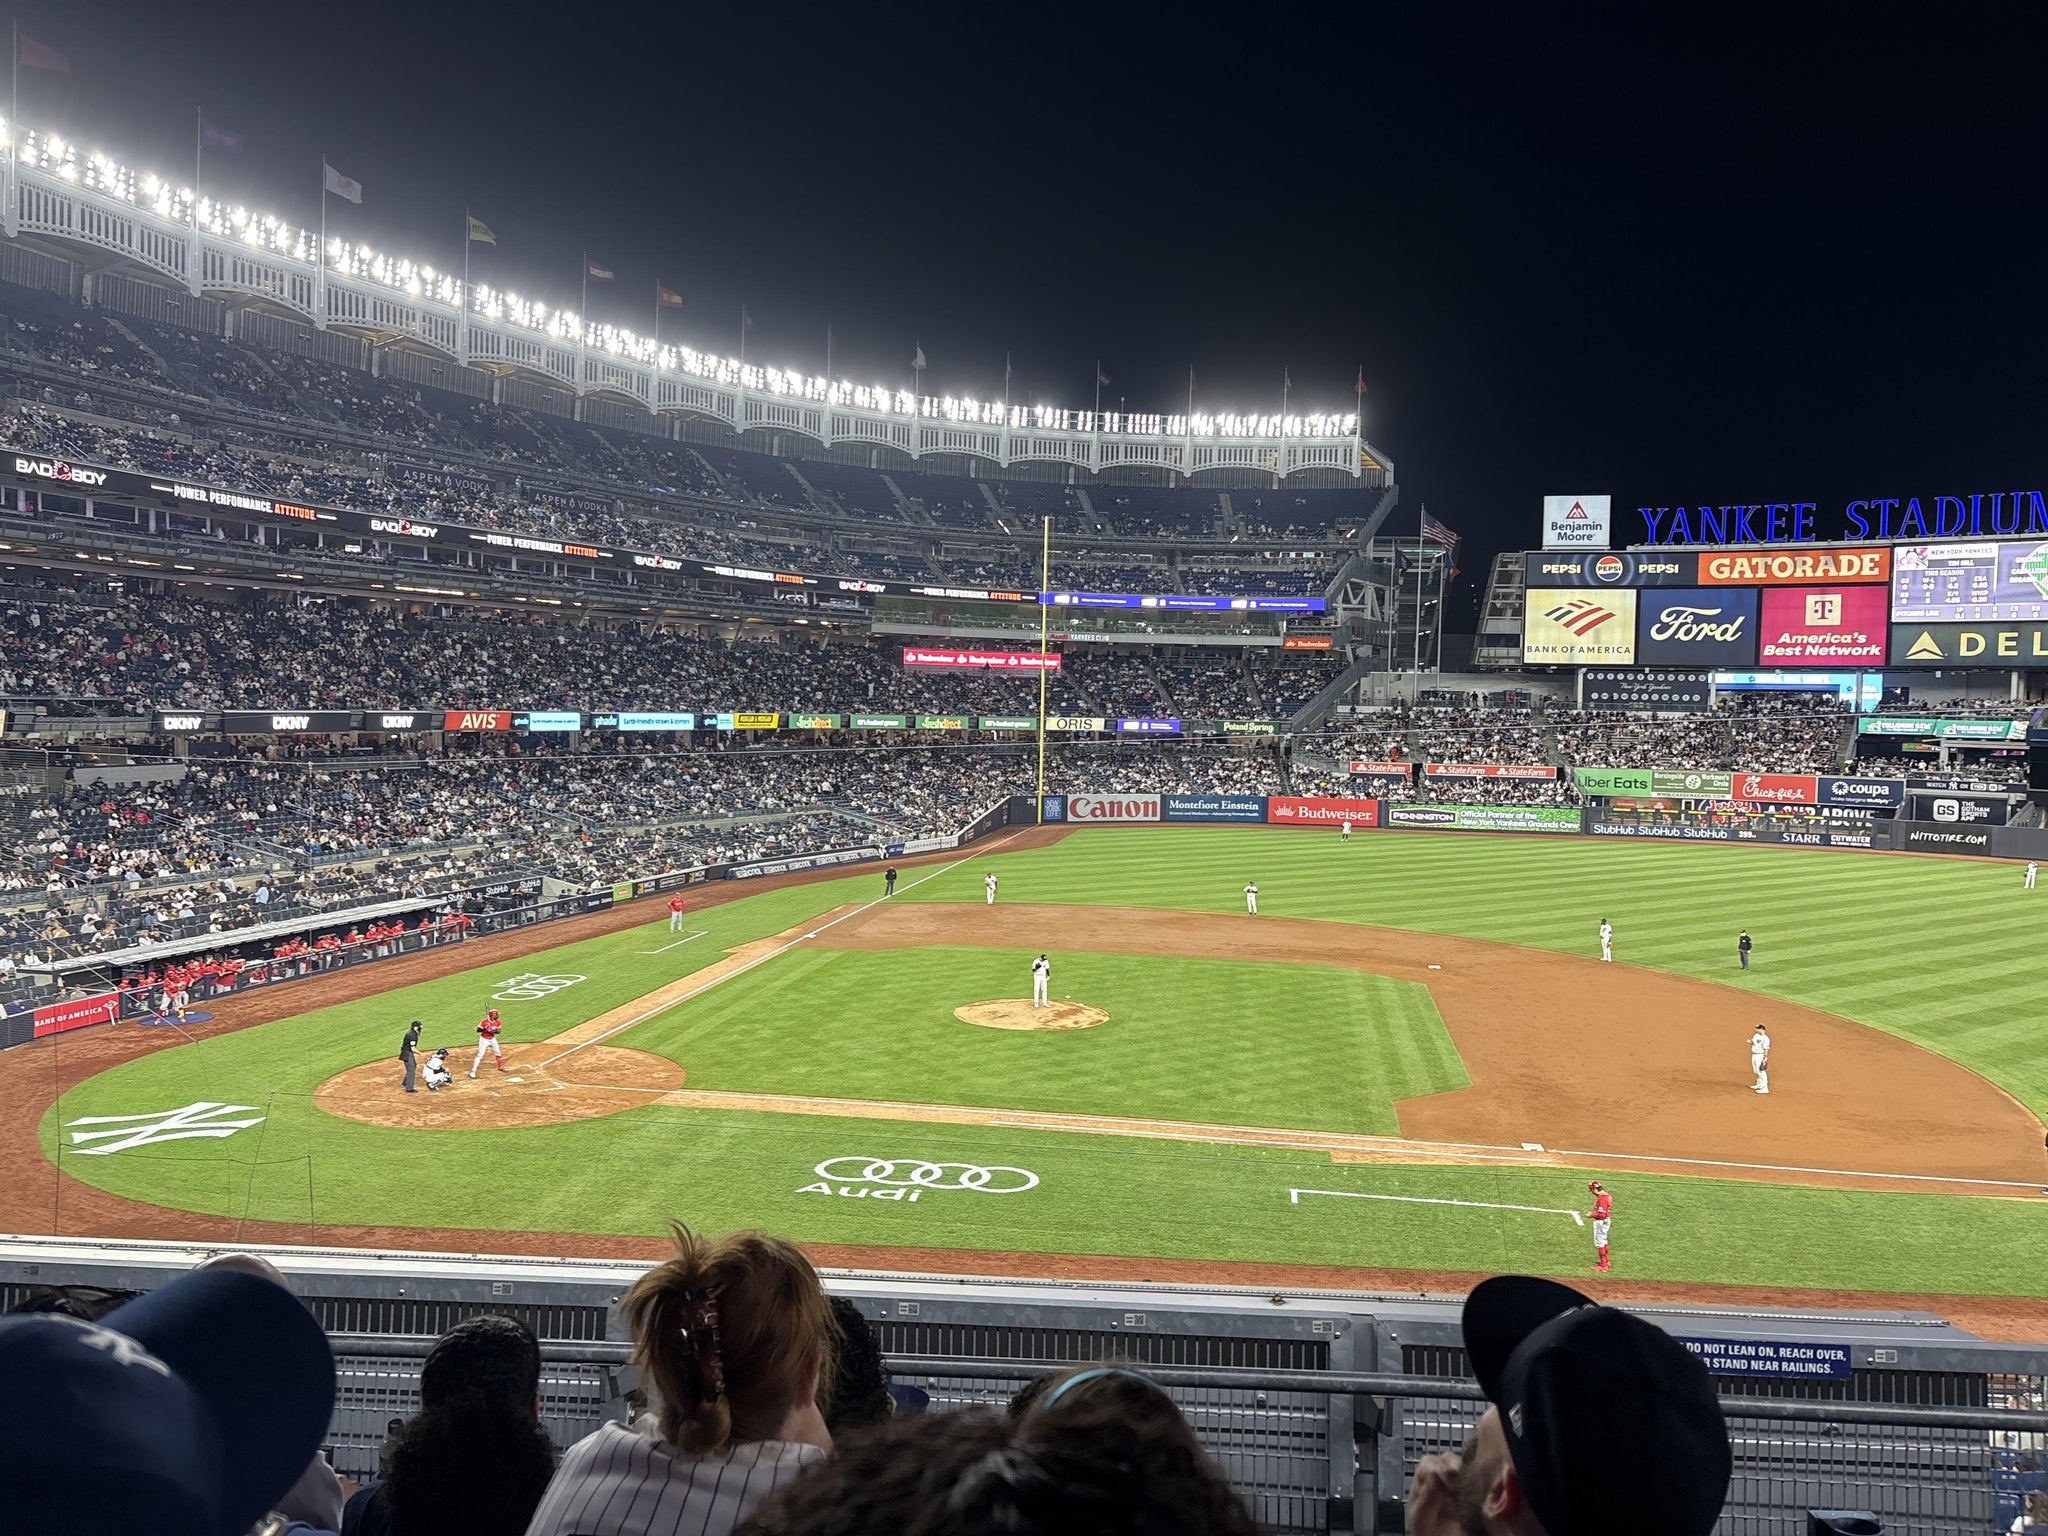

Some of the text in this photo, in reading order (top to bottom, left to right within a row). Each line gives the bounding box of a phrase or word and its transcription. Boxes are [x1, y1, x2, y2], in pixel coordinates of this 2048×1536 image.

[16, 458, 107, 486] BAD BOY
[403, 470, 491, 493] ASPEN VODKA
[173, 485, 208, 502] POWER.
[534, 493, 608, 514] ASPEN VODKA
[370, 520, 438, 538] BAD BOY
[1551, 521, 1602, 533] Benjamin
[1637, 503, 1818, 546] YANKEE
[1557, 532, 1593, 541] Moore
[635, 556, 682, 570] BAD BOY
[1542, 563, 1679, 574] PEPSI PEPSI PEPSI
[1710, 553, 1880, 580] GATORADE
[839, 580, 886, 593] BAD BOY
[1650, 606, 1746, 643] Ford
[1049, 632, 1068, 640] Audi
[1777, 631, 1868, 645] America's
[1526, 646, 1631, 654] BANK OF AMERICA
[1763, 643, 1882, 657] Best Network
[164, 717, 202, 730] DKNY
[273, 716, 310, 730] DKNY
[382, 715, 414, 729] DKNY
[460, 714, 497, 729] AVIS
[796, 716, 832, 729] freshdirect
[922, 717, 962, 729] freshdirect
[1056, 718, 1092, 729] ORIS
[1223, 721, 1274, 733] Poland Spring
[1578, 776, 1612, 789] Uber
[1614, 777, 1648, 790] Eats
[1713, 780, 1730, 788] Circle
[1742, 781, 1806, 800] Chick-fil-A
[1849, 783, 1889, 798] coupa
[1069, 797, 1158, 819] Canon
[1168, 800, 1259, 811] Montefiore Einstein
[1705, 800, 1752, 813] Jersey
[1937, 804, 1955, 815] GS
[1297, 806, 1372, 820] Budweiser
[1392, 812, 1454, 822] PENNINGTON
[1460, 810, 1487, 818] Official
[1488, 811, 1514, 819] Partner
[1496, 819, 1526, 827] Yankees
[1593, 824, 1728, 839] StubHub StubHub StubHub
[1738, 830, 1752, 839] 399
[1782, 833, 1820, 844] STARR
[1910, 830, 1987, 845] NITTOTIRE.COM
[1830, 835, 1870, 843] CUTWATER
[486, 885, 509, 896] StubHub
[35, 1007, 103, 1027] BANK OF AMERICA
[794, 1182, 923, 1203] Audi
[1687, 1342, 1847, 1362] DO NOT LEAN ON, REACH OVER,
[1712, 1357, 1833, 1374] STAND NEAR RAILINGS.
